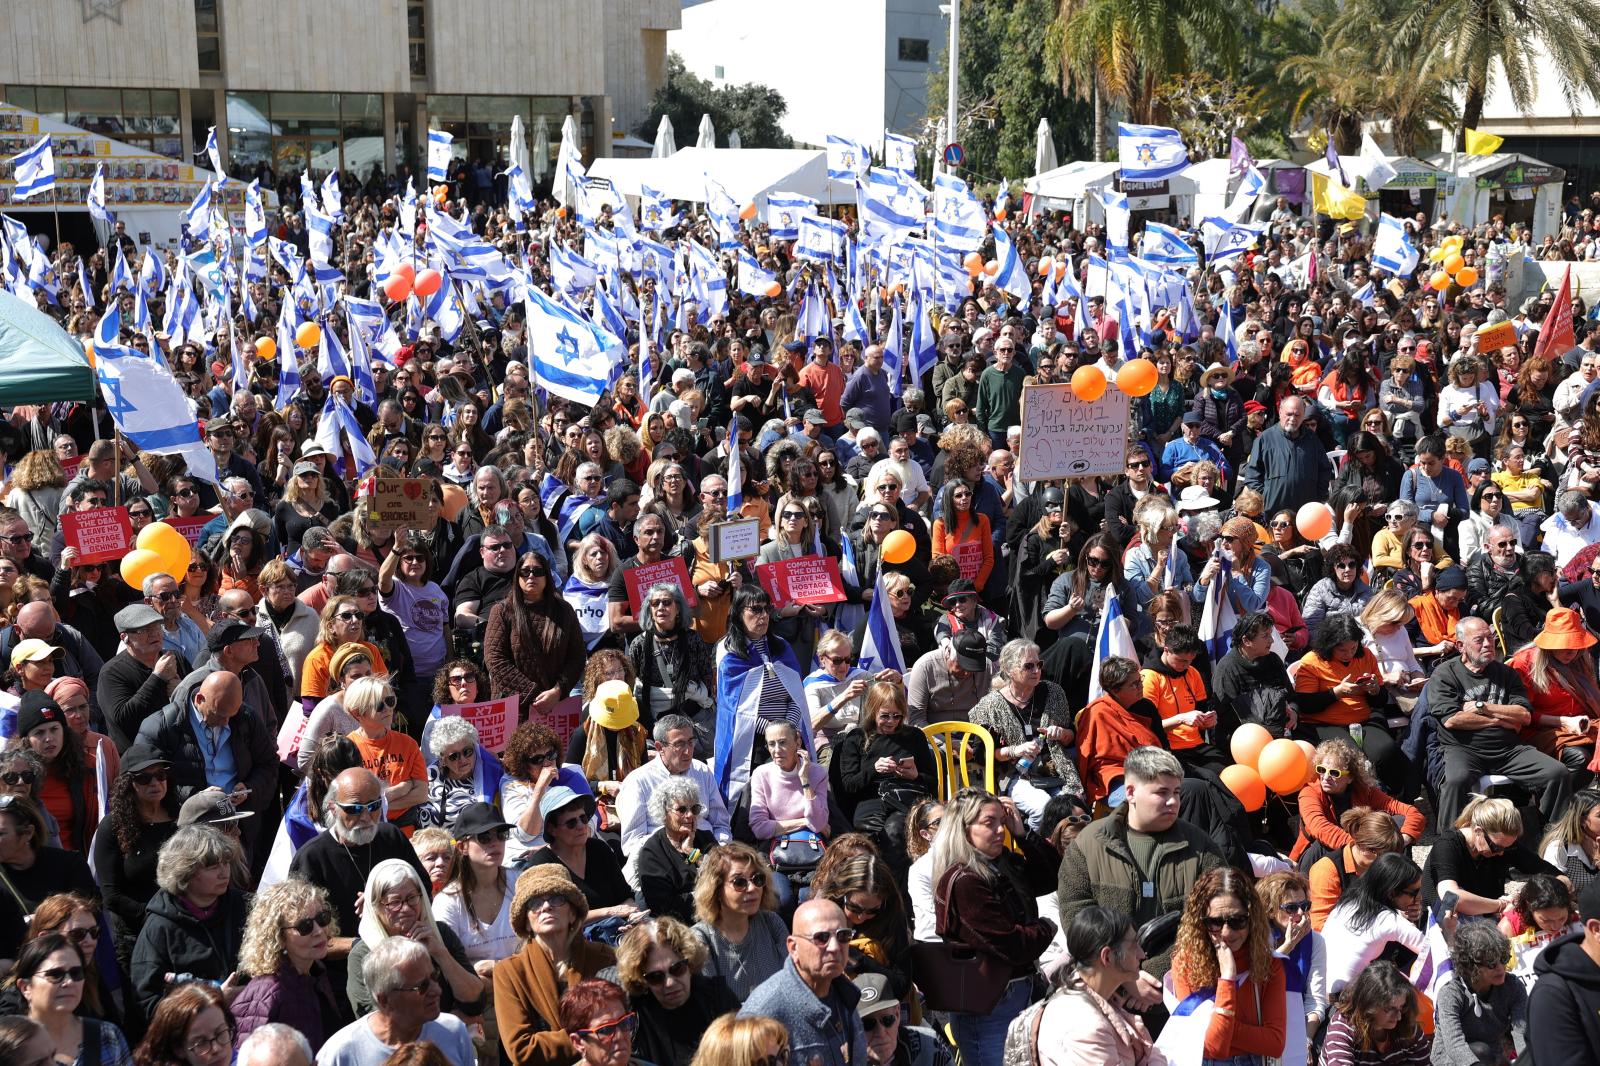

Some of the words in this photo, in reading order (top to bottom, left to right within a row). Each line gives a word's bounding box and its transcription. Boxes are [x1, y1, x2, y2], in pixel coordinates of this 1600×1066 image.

[1069, 406, 1110, 426] בטמן
[1027, 423, 1041, 438] על
[376, 481, 400, 494] Our
[75, 509, 117, 521] COMPLETE
[380, 511, 416, 521] BROKEN
[78, 519, 96, 528] THE
[97, 516, 117, 525] DEAL
[81, 526, 106, 537] LEAVE
[107, 525, 119, 533] NO
[83, 533, 121, 546] HOSTAGE
[89, 542, 119, 553] BEHIND
[635, 561, 675, 576] COMPLETE
[786, 559, 827, 569] COMPLETE
[805, 565, 824, 573] DEAL
[639, 574, 655, 583] THE
[655, 569, 674, 579] DEAL
[791, 574, 814, 583] LEAVE
[791, 581, 829, 591] HOSTAGE
[797, 589, 827, 598] BEHIND
[475, 705, 493, 716] לא
[466, 714, 505, 727] עוצרו
[479, 734, 505, 749] בבי
